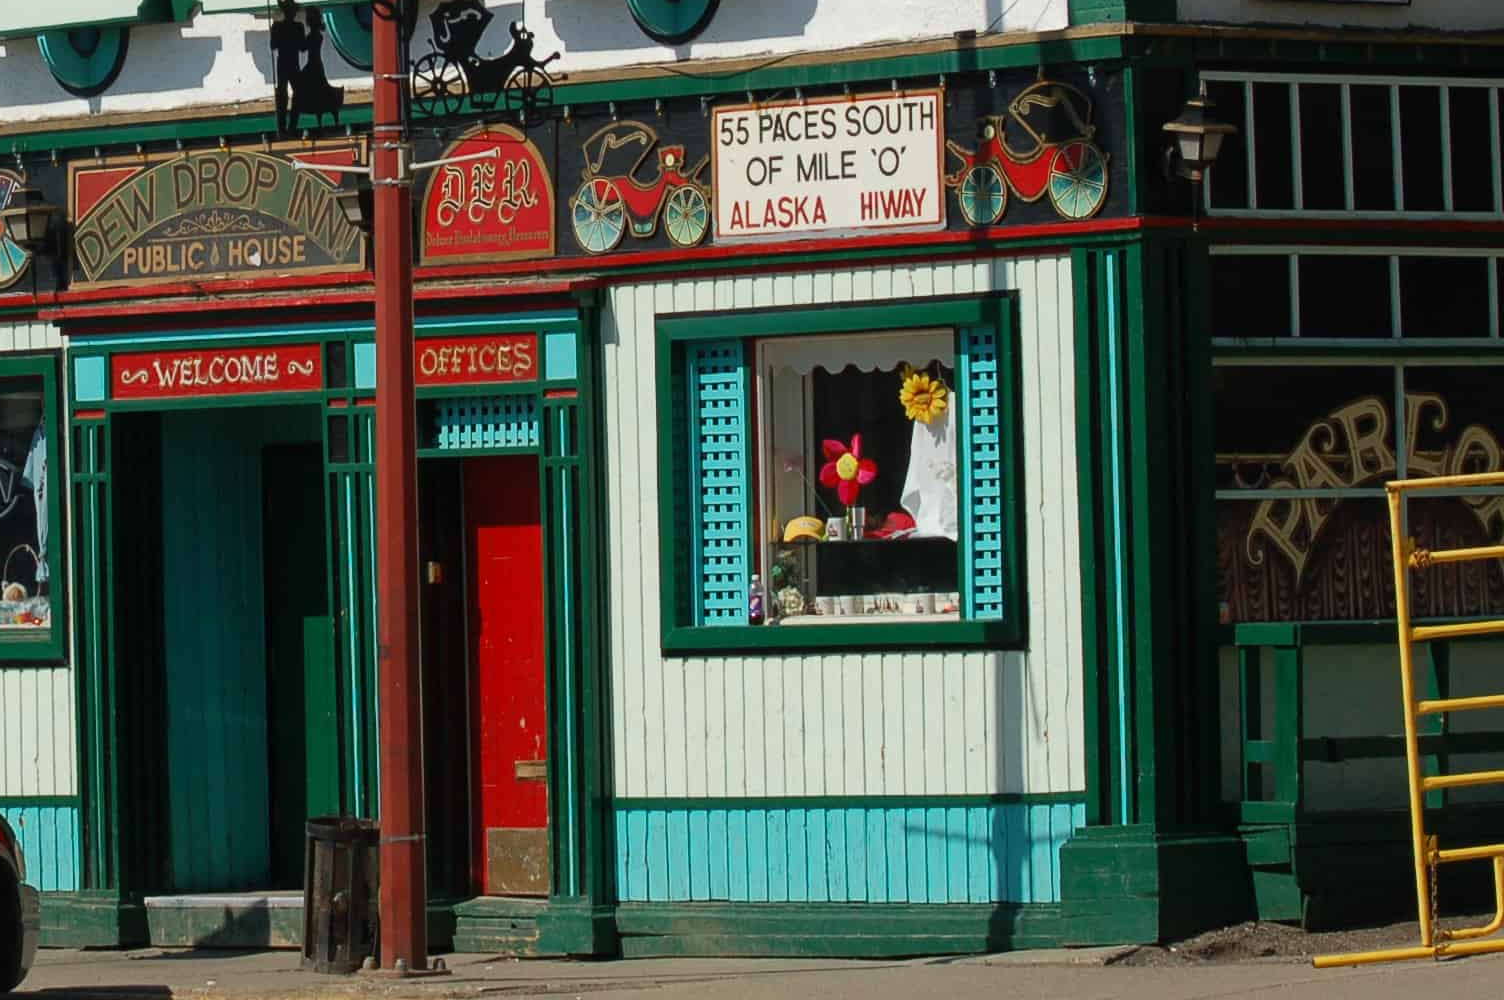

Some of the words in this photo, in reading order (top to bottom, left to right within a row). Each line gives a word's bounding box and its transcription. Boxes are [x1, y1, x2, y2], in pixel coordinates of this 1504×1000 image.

[720, 117, 749, 146] 55
[758, 107, 837, 144] PACES
[845, 101, 935, 137] SOUTH
[746, 155, 784, 186] OF
[796, 150, 857, 183] MILE
[75, 172, 157, 277] DEW
[171, 155, 279, 207] DROP
[729, 195, 828, 230] ALASKA
[860, 187, 928, 221] HIWAY
[123, 241, 205, 275] PUBLIC
[228, 234, 307, 267] HOUSE
[153, 352, 280, 388] WELCOME
[419, 342, 533, 377] OFFICES
[1247, 392, 1504, 586] PARLO
